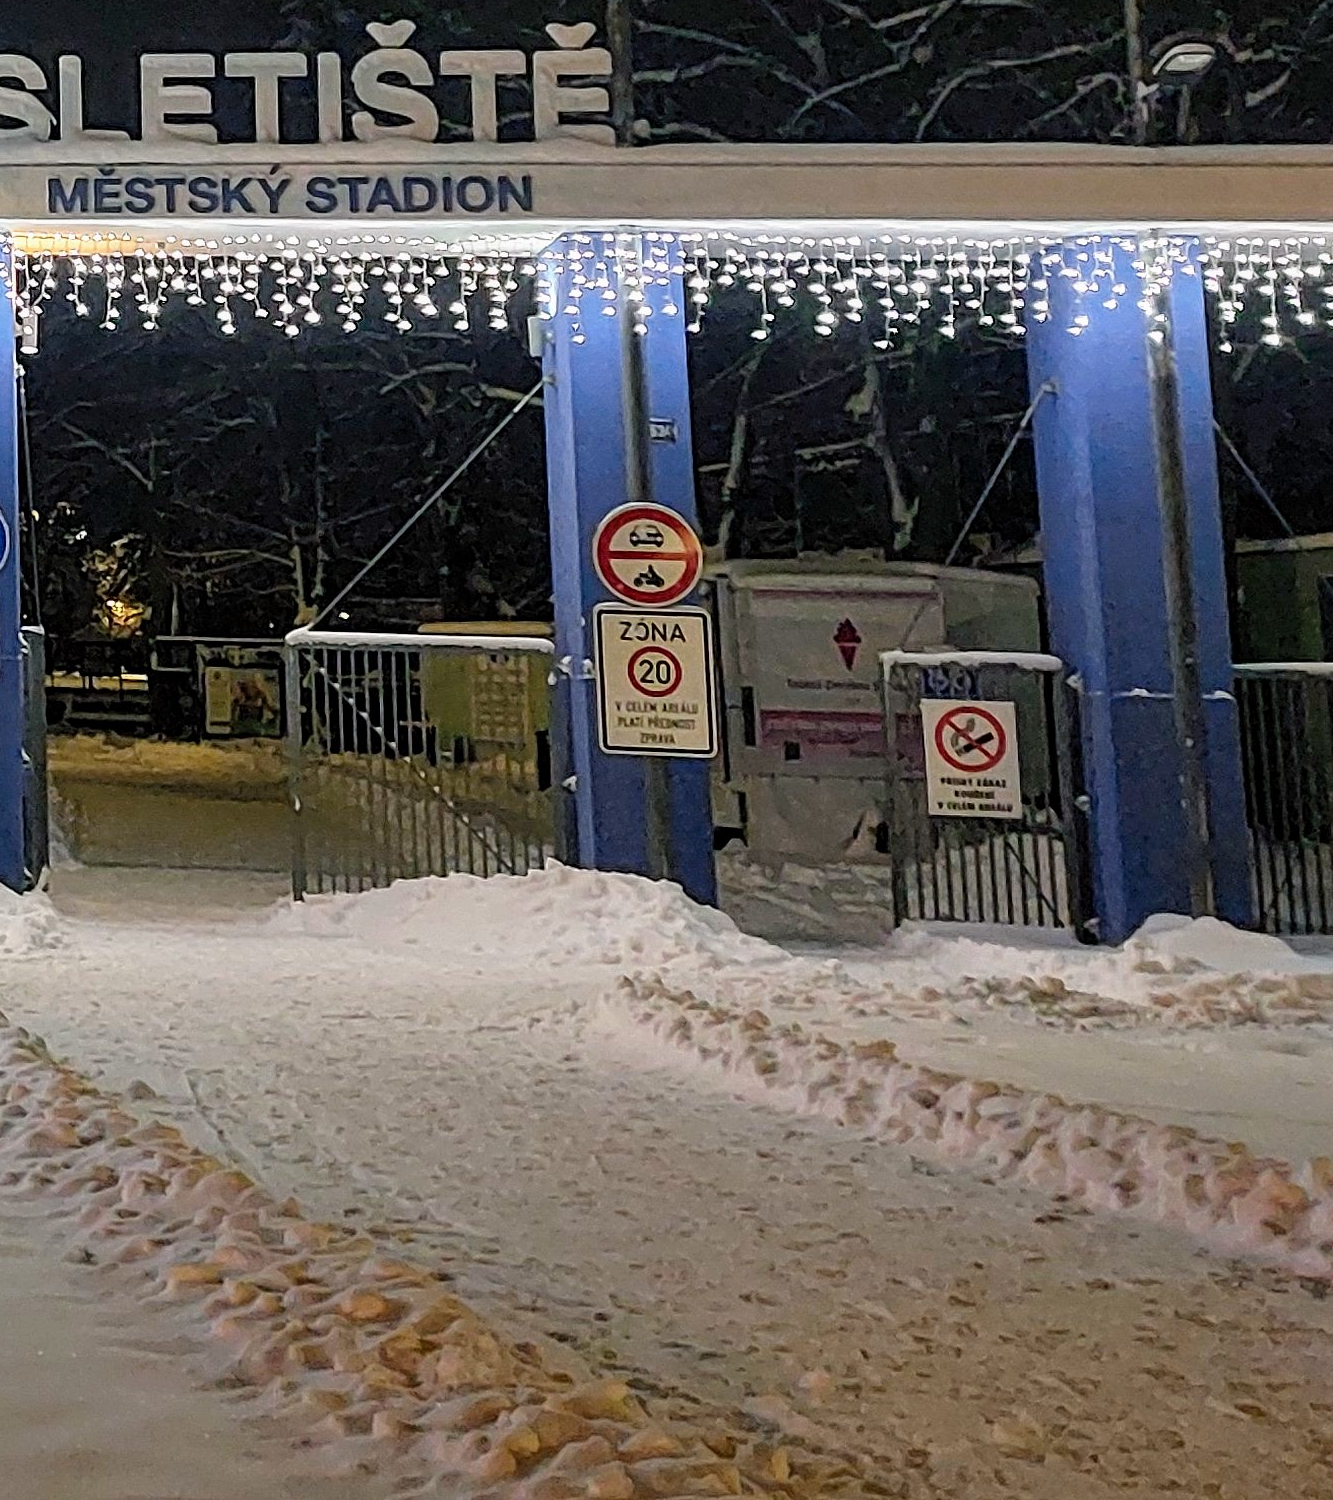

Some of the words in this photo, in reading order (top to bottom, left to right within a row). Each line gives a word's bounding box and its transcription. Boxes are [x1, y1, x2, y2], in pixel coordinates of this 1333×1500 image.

[47, 163, 291, 214] MĚSTSKÝ
[305, 175, 533, 214] STADION
[619, 618, 686, 642] ZÓNA
[639, 659, 671, 684] 20
